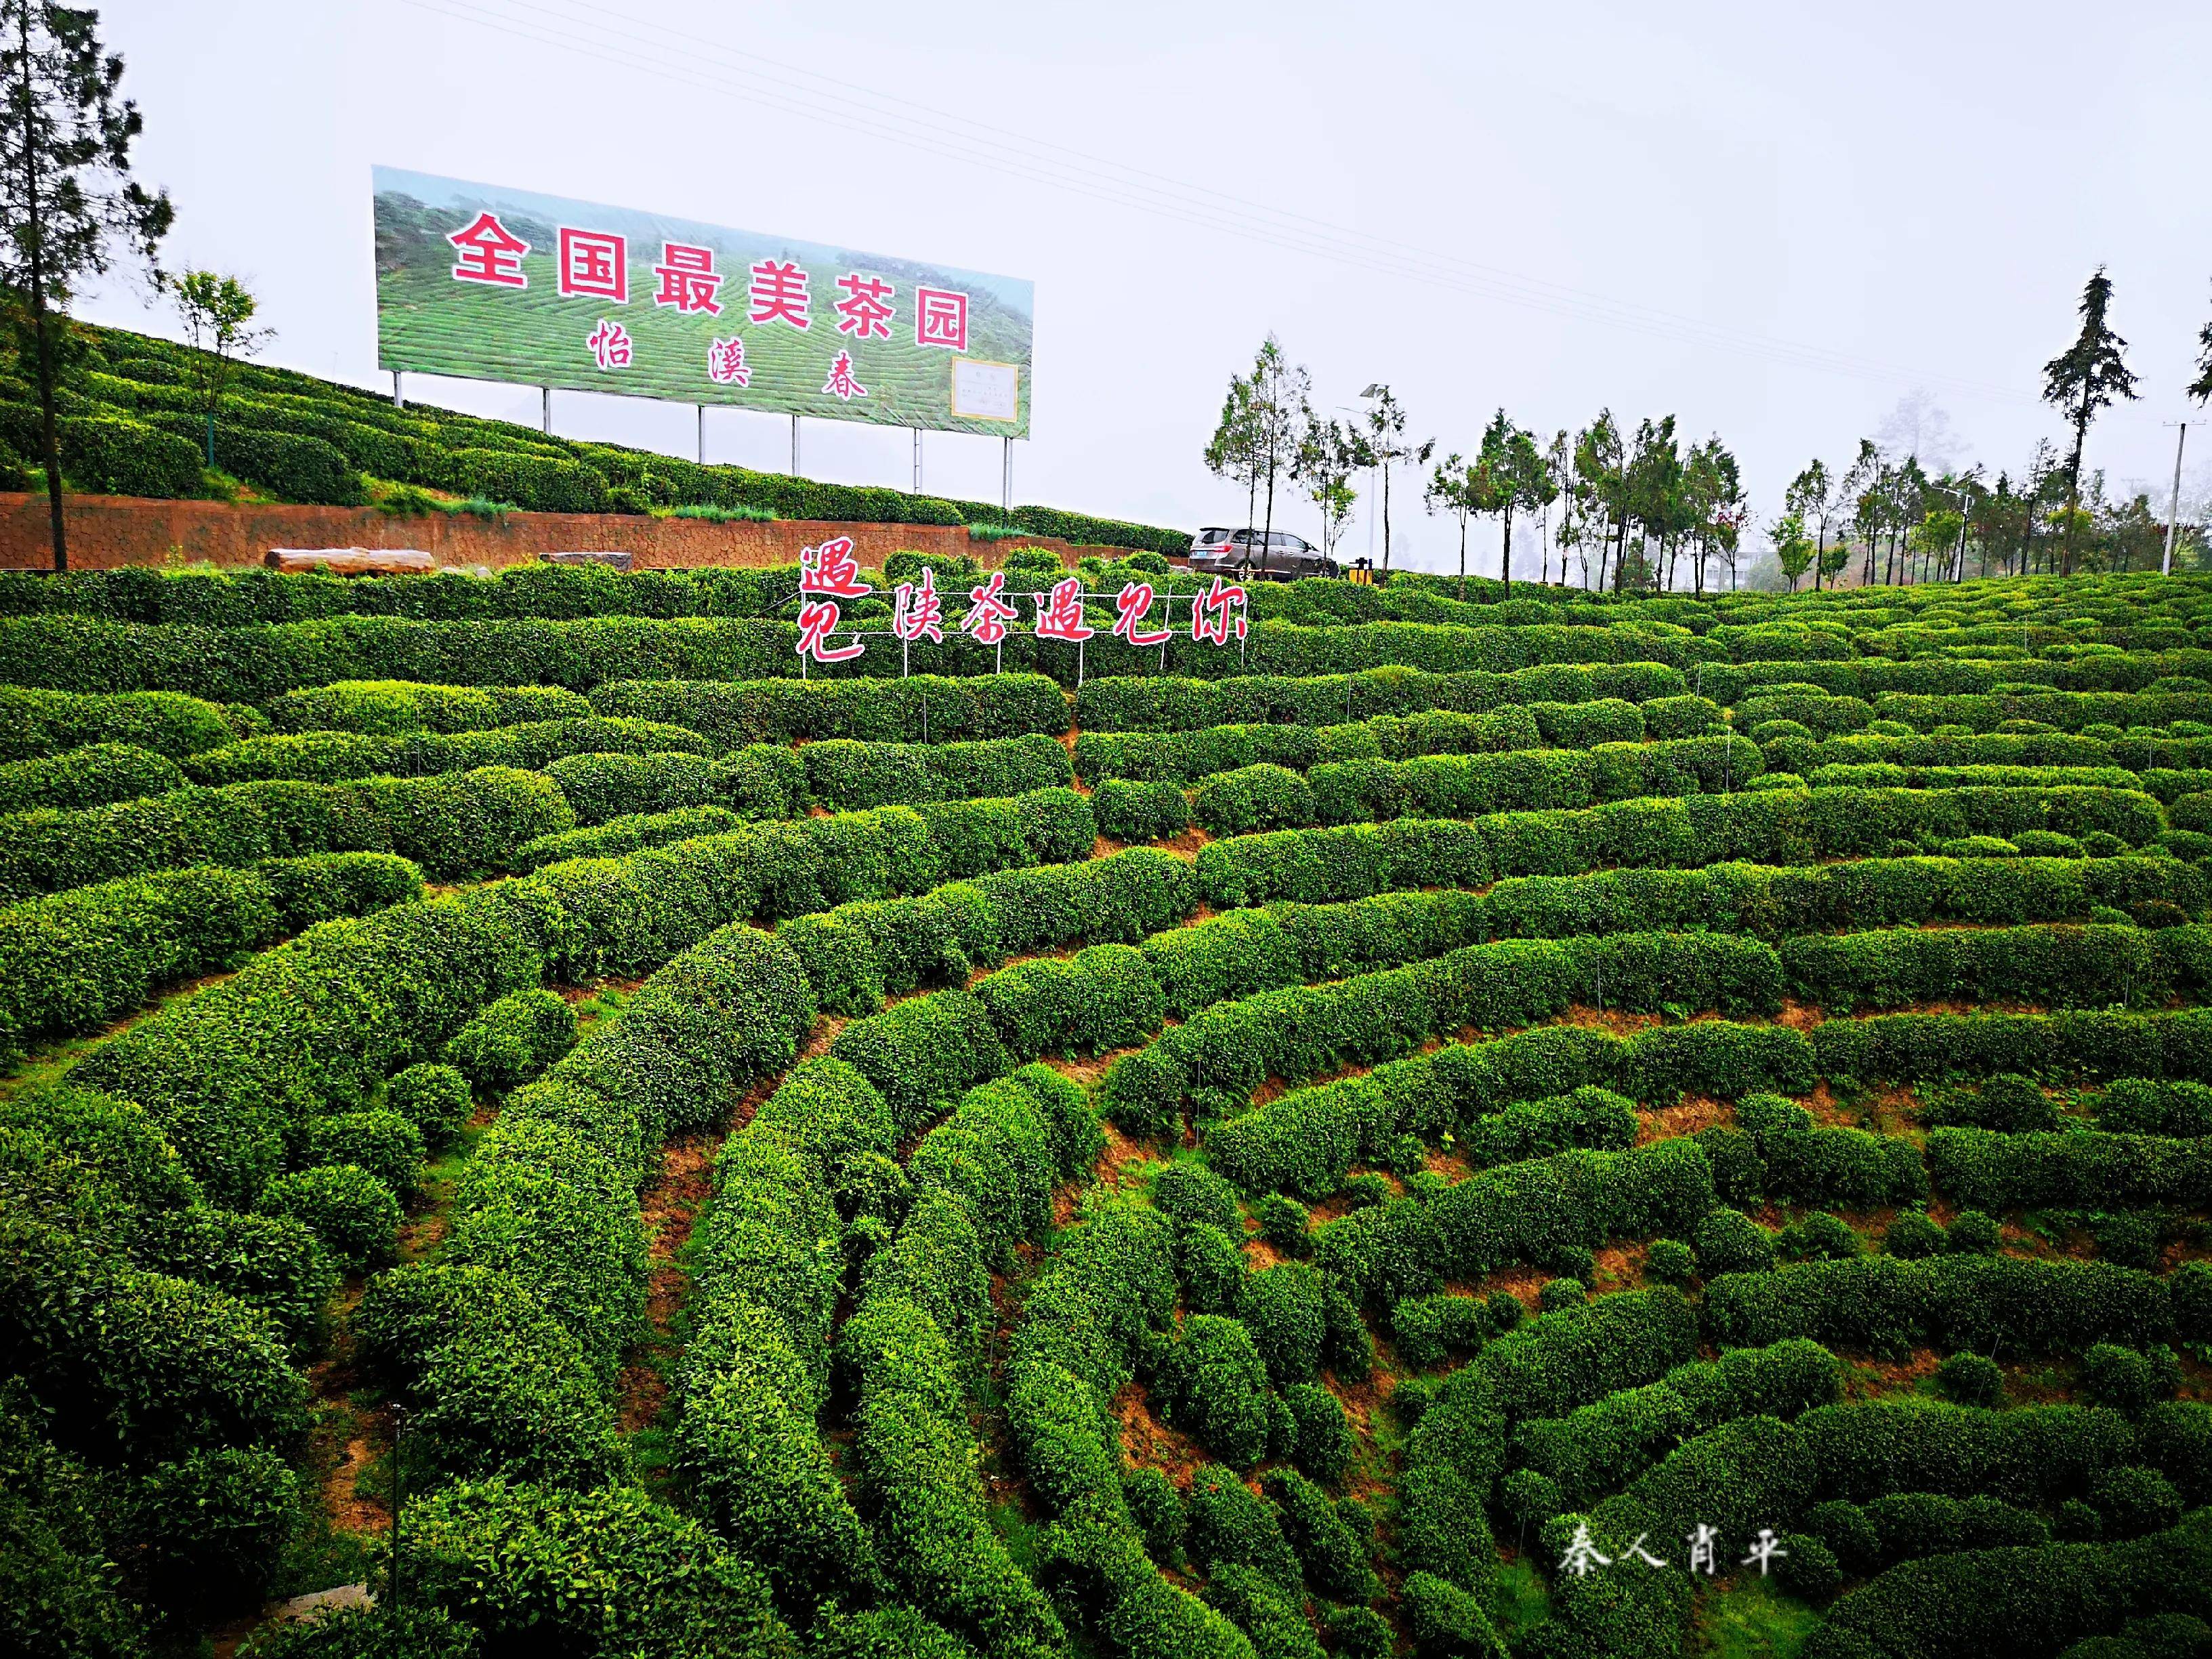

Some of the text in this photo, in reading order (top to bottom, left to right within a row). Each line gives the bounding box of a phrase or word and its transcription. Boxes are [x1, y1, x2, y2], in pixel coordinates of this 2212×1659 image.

[446, 211, 969, 352] 全国最美茶园
[587, 318, 868, 401] 怡溪春
[892, 566, 1247, 646] 陕茶遇见你
